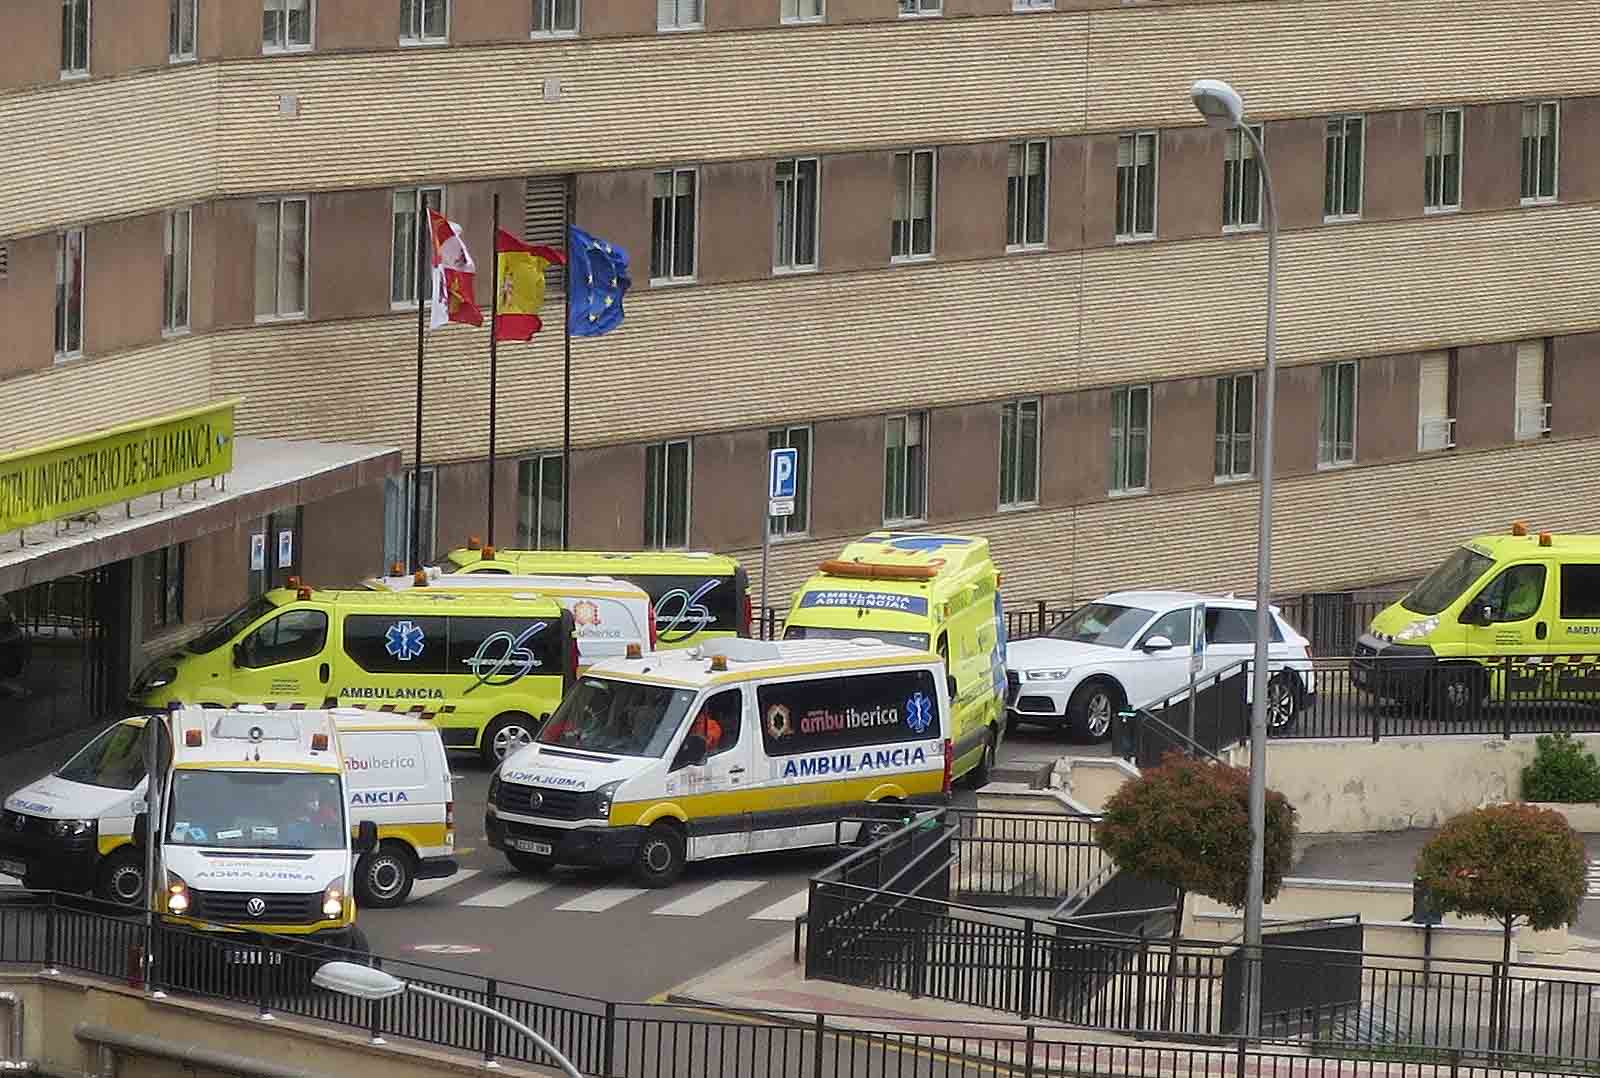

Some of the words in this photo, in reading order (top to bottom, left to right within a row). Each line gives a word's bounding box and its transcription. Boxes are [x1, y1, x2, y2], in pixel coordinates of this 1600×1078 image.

[32, 446, 120, 510] UNIVERSITARIO
[123, 443, 137, 487] DE
[141, 423, 212, 482] SALAMANCA
[775, 455, 792, 497] P
[339, 687, 444, 699] AMBULANCIA
[783, 746, 925, 778] AMBULANCIA
